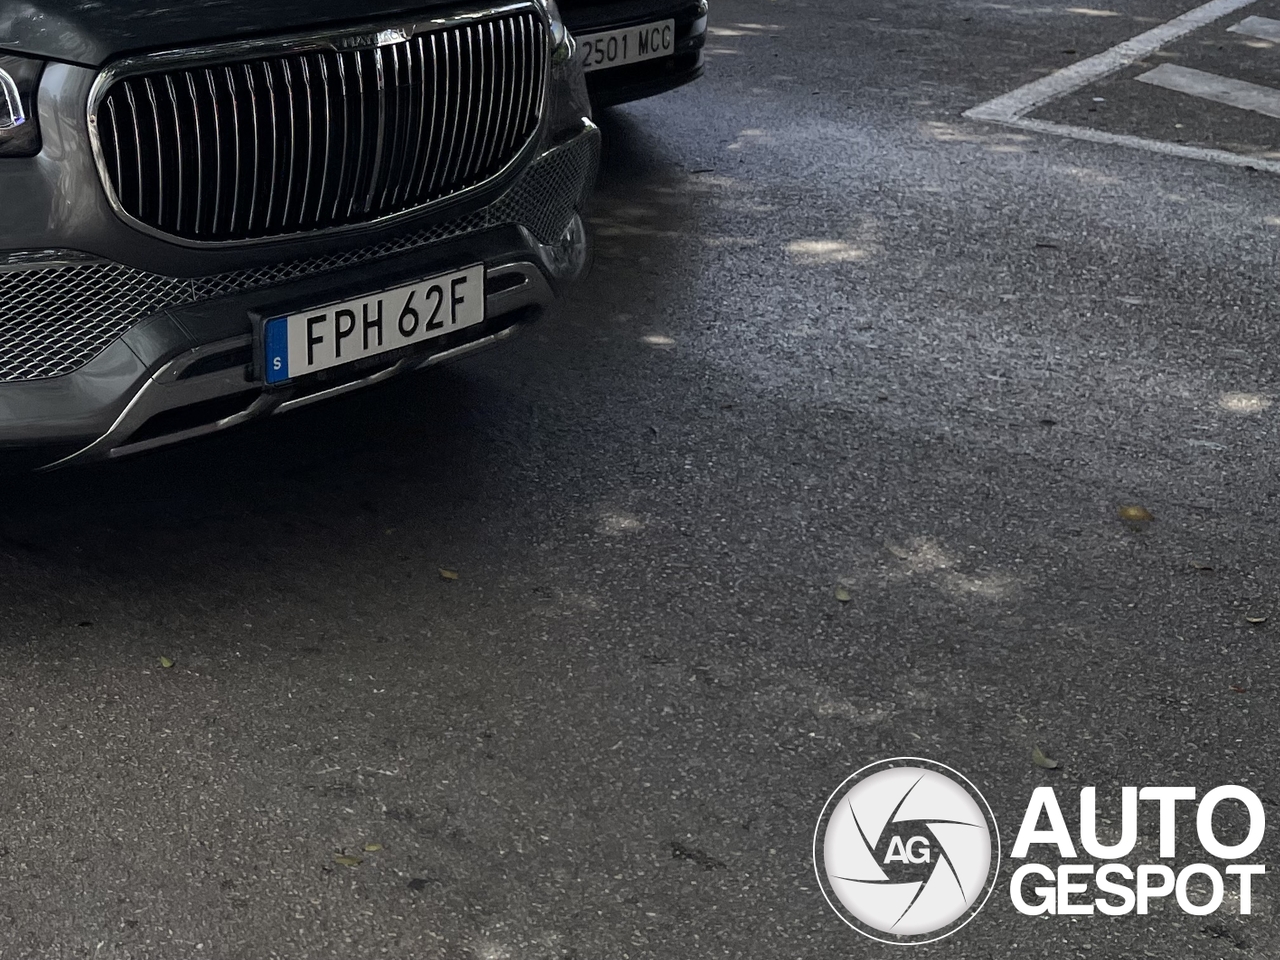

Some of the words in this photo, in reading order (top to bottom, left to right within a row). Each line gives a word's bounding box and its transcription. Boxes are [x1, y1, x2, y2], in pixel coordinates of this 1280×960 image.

[581, 34, 628, 67] 2501
[638, 24, 671, 56] MCC
[306, 299, 383, 365] FPH
[398, 276, 468, 337] 62F
[273, 357, 281, 371] S
